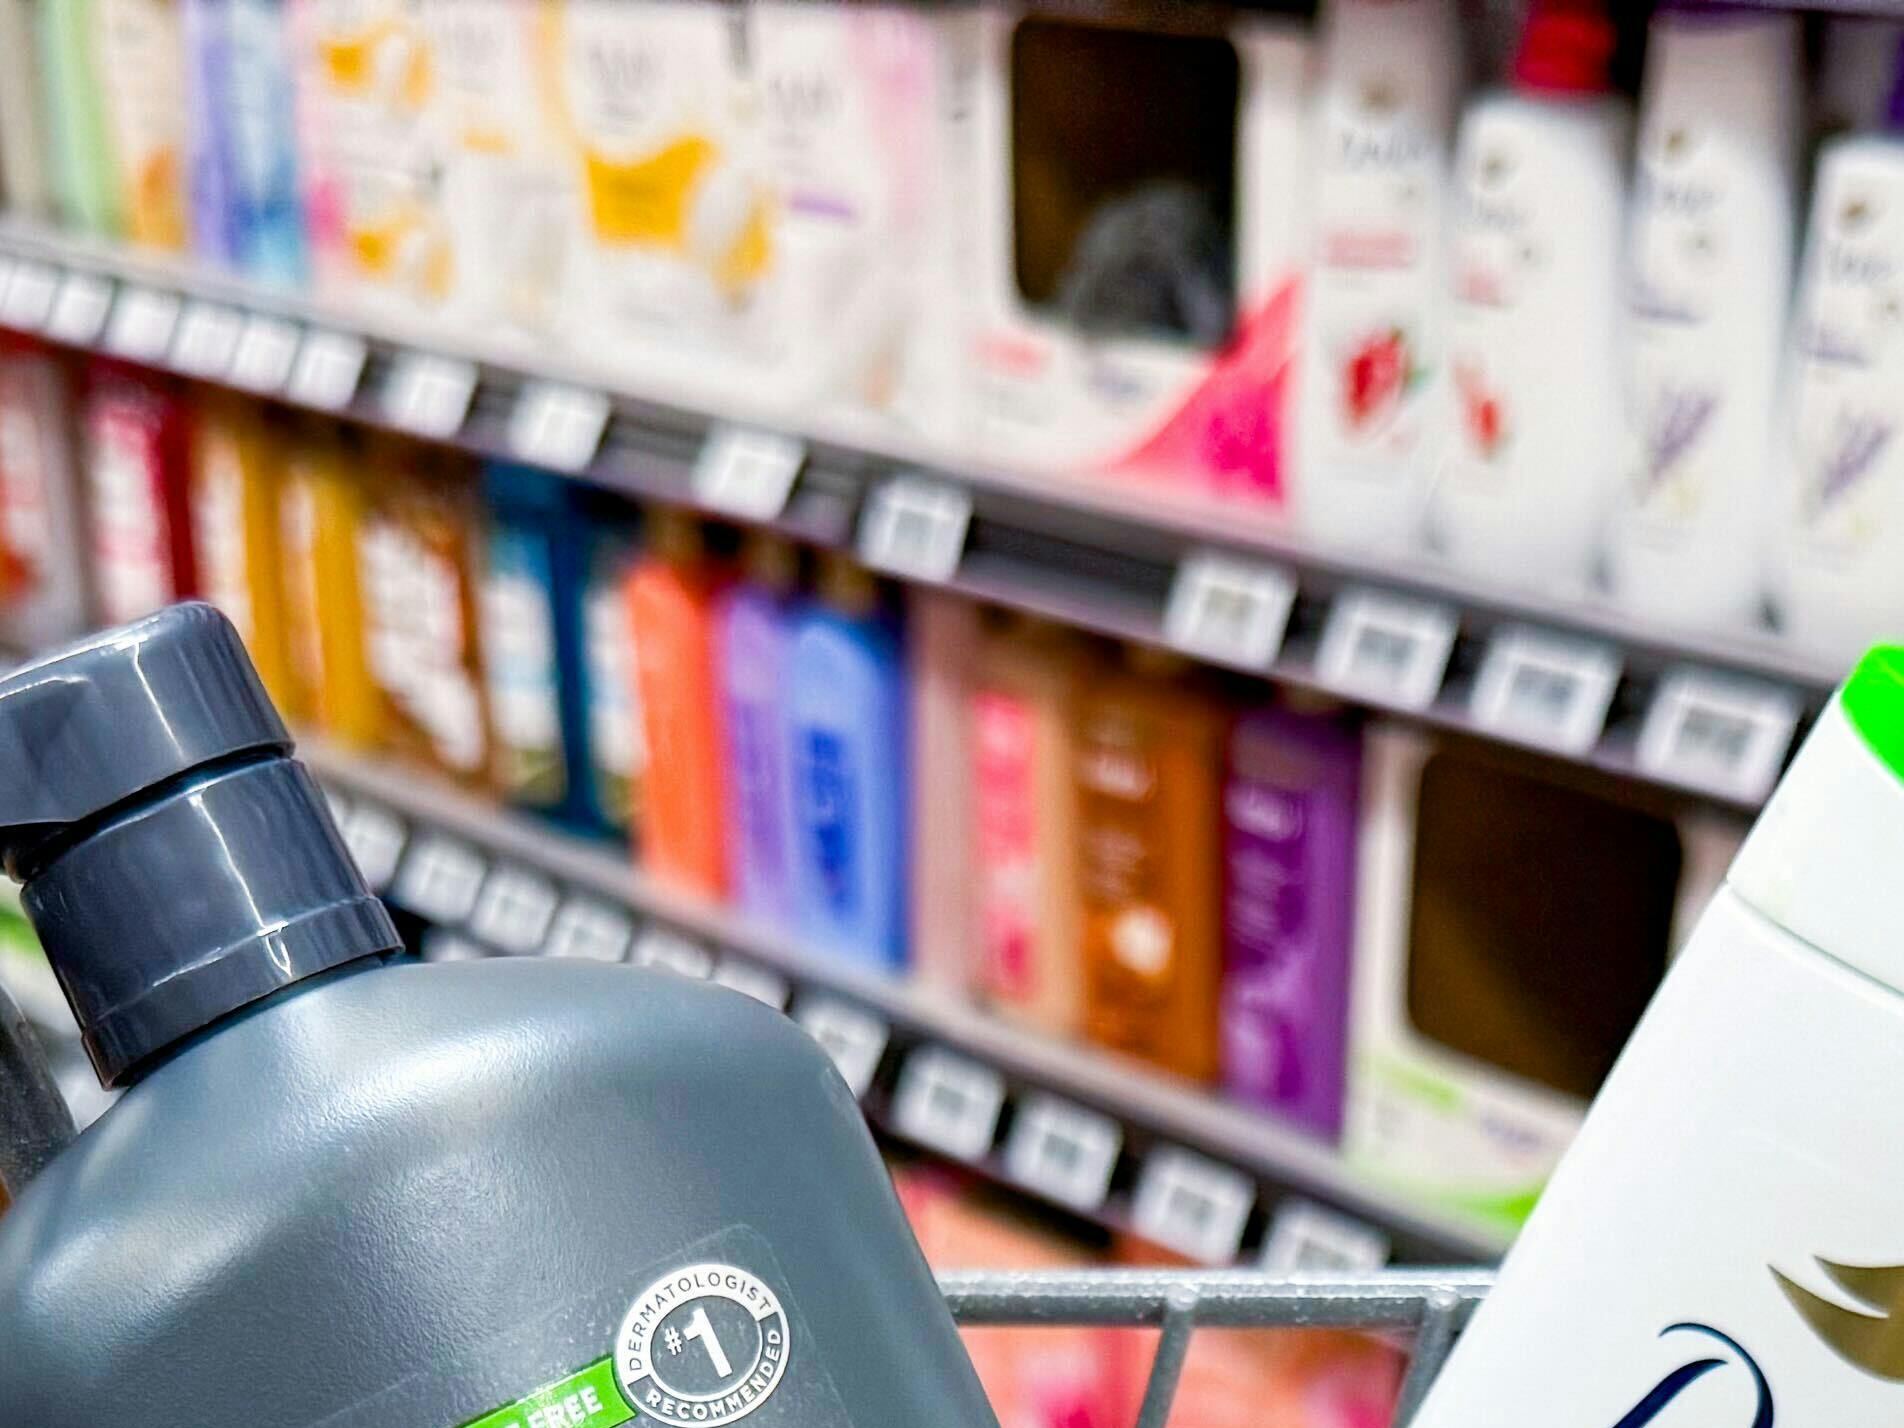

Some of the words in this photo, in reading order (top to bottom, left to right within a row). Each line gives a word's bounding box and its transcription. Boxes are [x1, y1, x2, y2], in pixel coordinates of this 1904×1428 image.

[628, 1272, 772, 1371] DERMATOLOGIST
[664, 1306, 733, 1379] #1
[646, 1328, 782, 1421] RECOMMENDED
